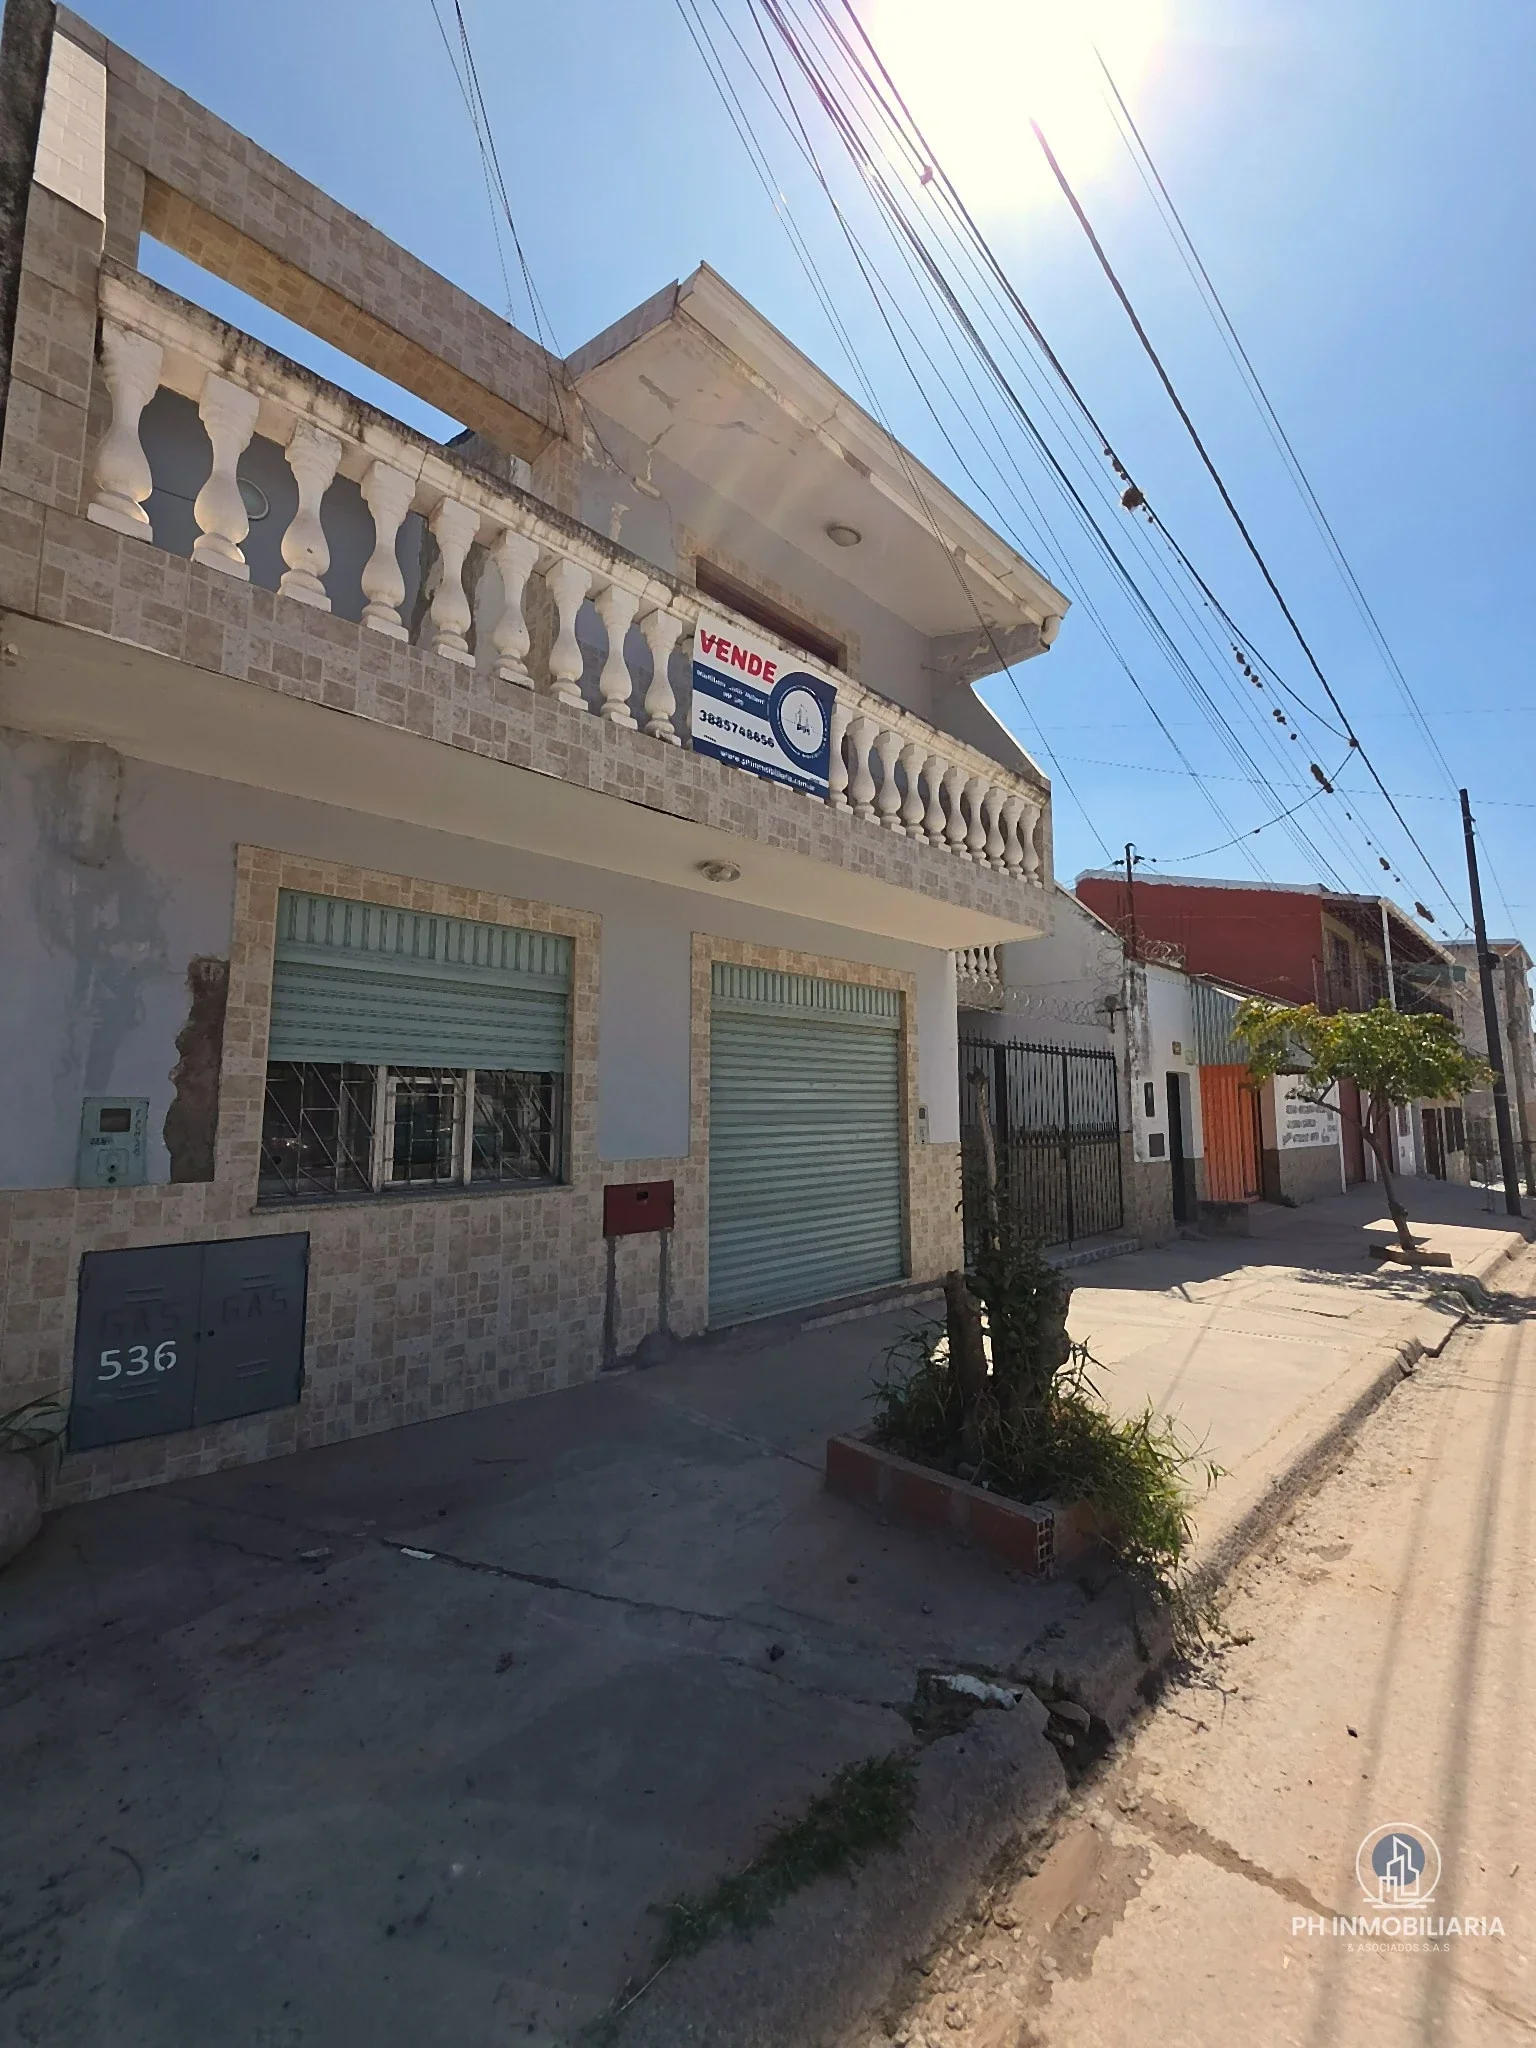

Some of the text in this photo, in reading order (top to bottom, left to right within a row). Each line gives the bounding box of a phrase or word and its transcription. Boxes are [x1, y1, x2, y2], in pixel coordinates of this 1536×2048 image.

[700, 629, 778, 684] VENDE
[101, 1302, 181, 1338] GAS
[222, 1288, 288, 1324] GAS
[97, 1340, 177, 1381] 536
